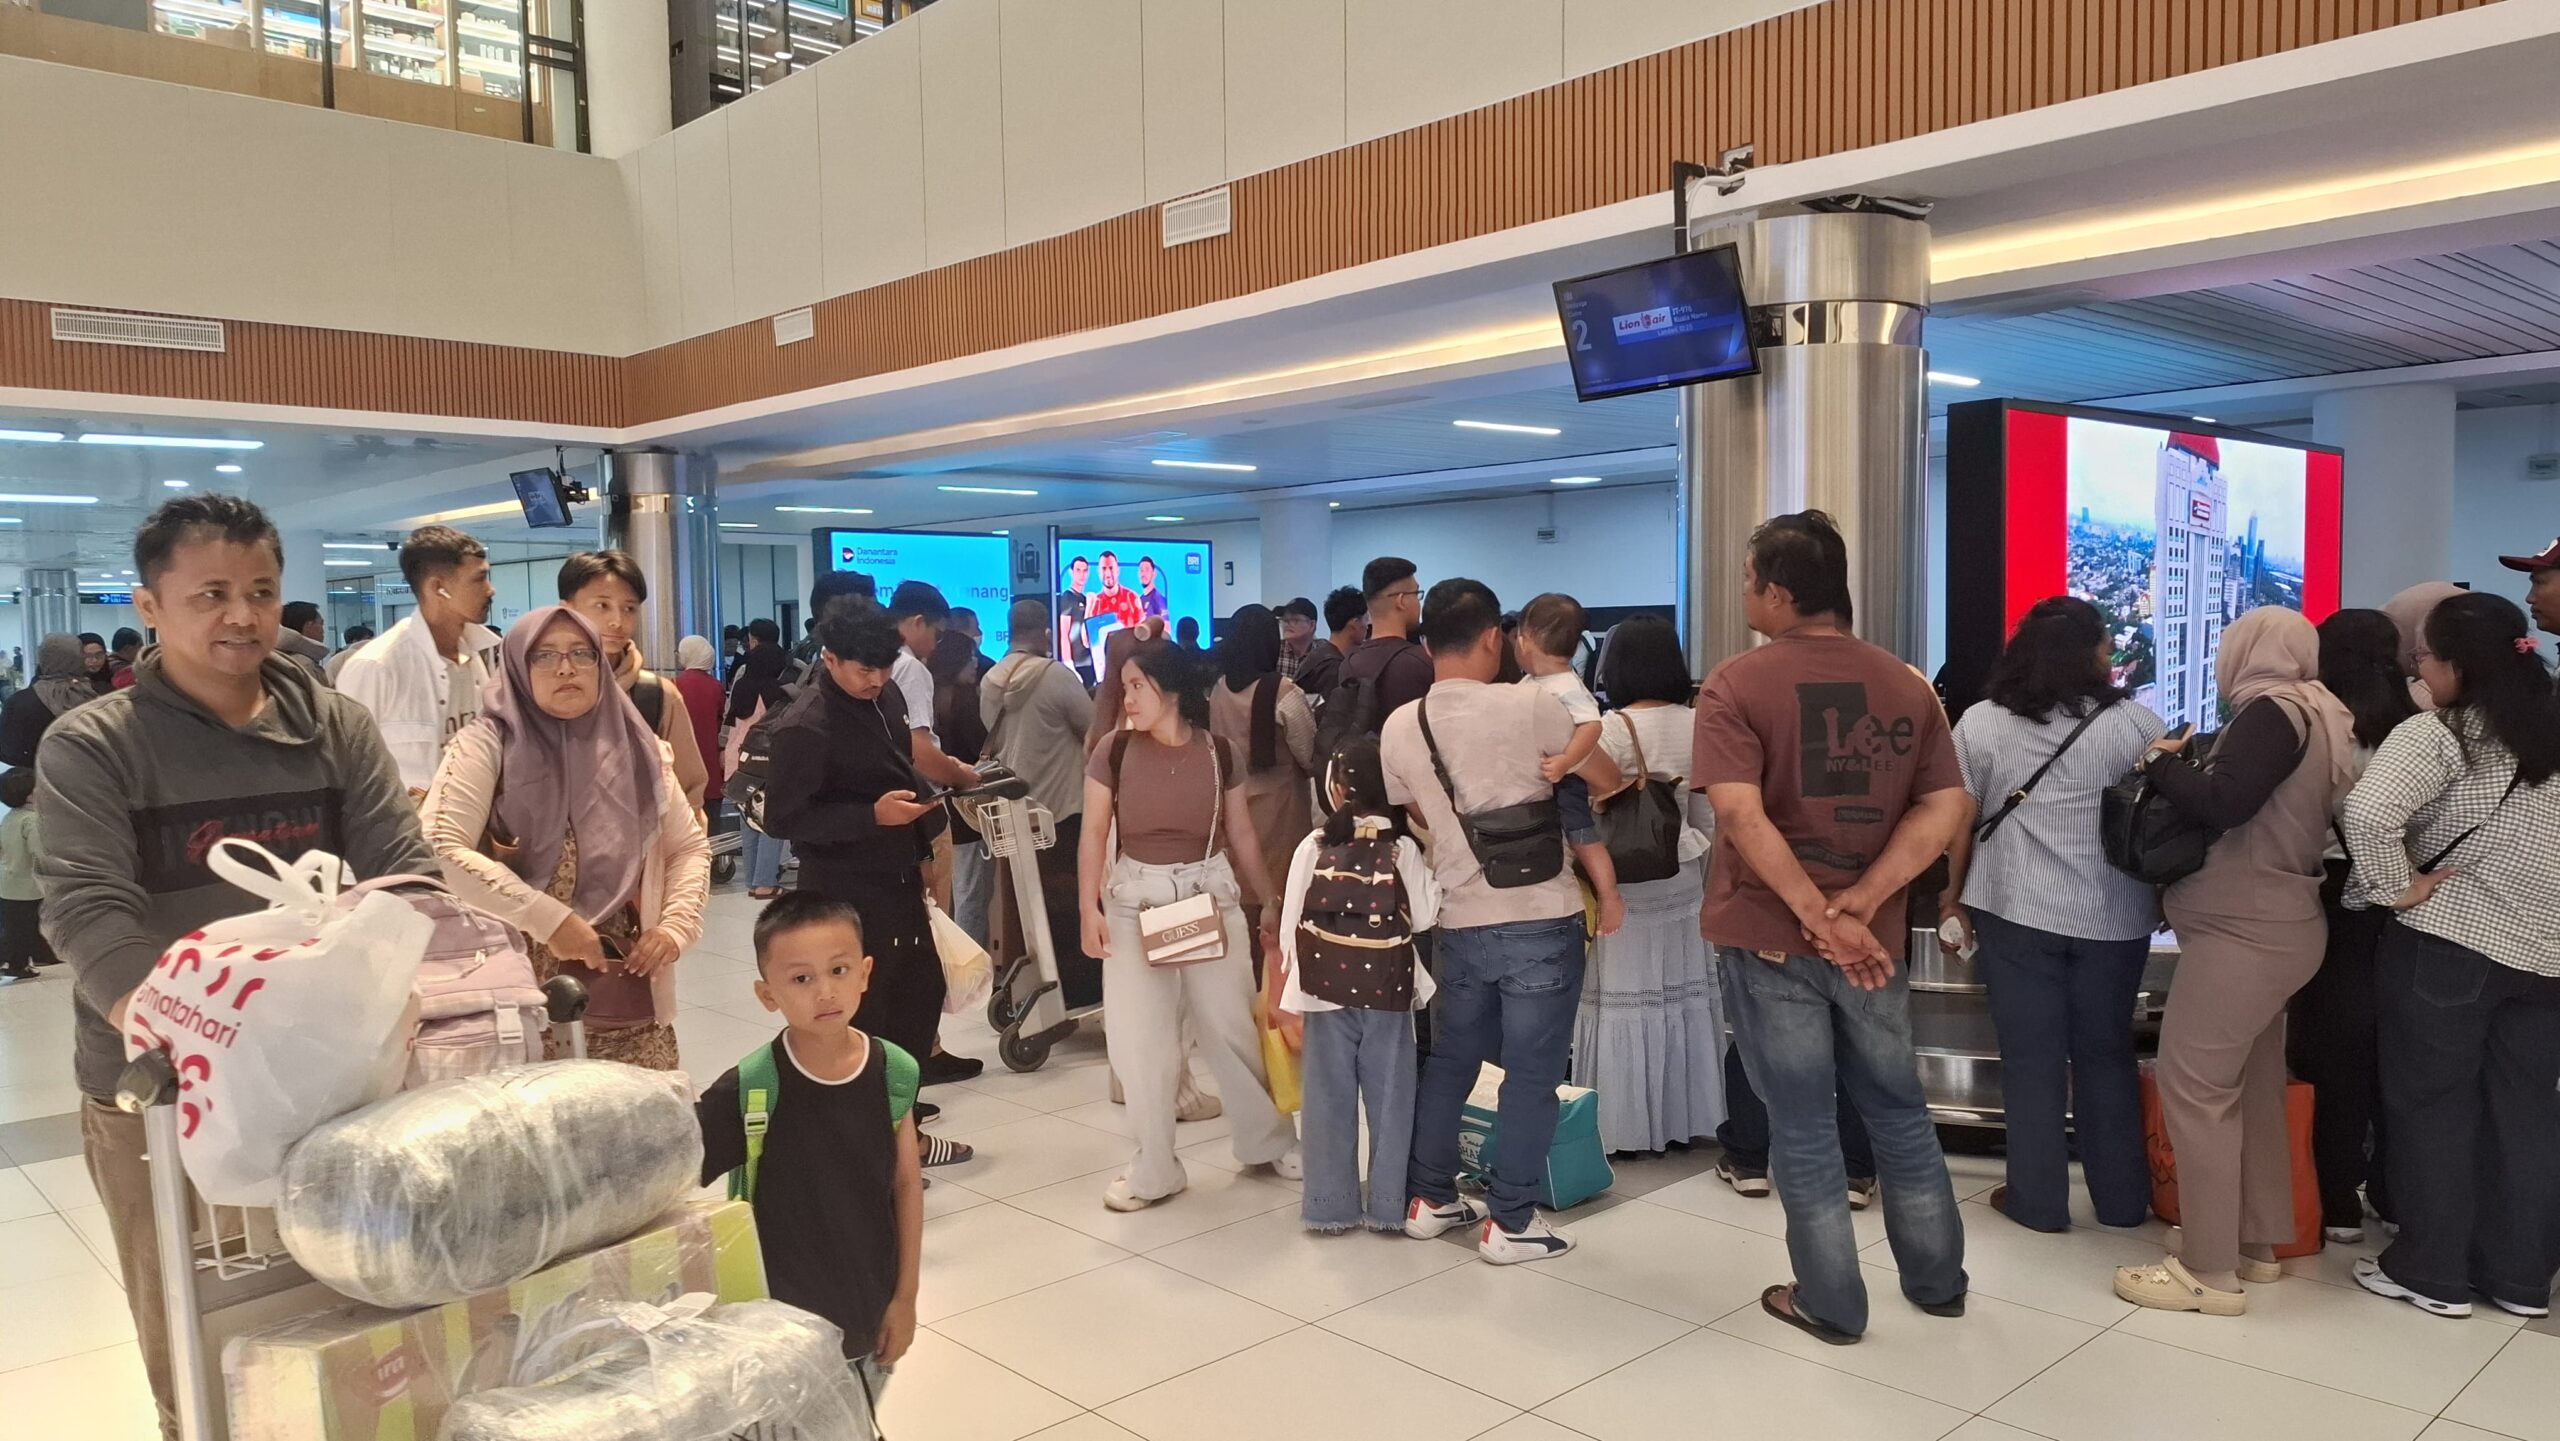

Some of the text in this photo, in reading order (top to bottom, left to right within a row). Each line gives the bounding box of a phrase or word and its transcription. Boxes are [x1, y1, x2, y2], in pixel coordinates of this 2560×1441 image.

[1572, 319, 1592, 351] 2
[857, 556, 896, 565] Indonesia
[1822, 706, 1914, 757] Lee
[1161, 921, 1200, 943] GUESS
